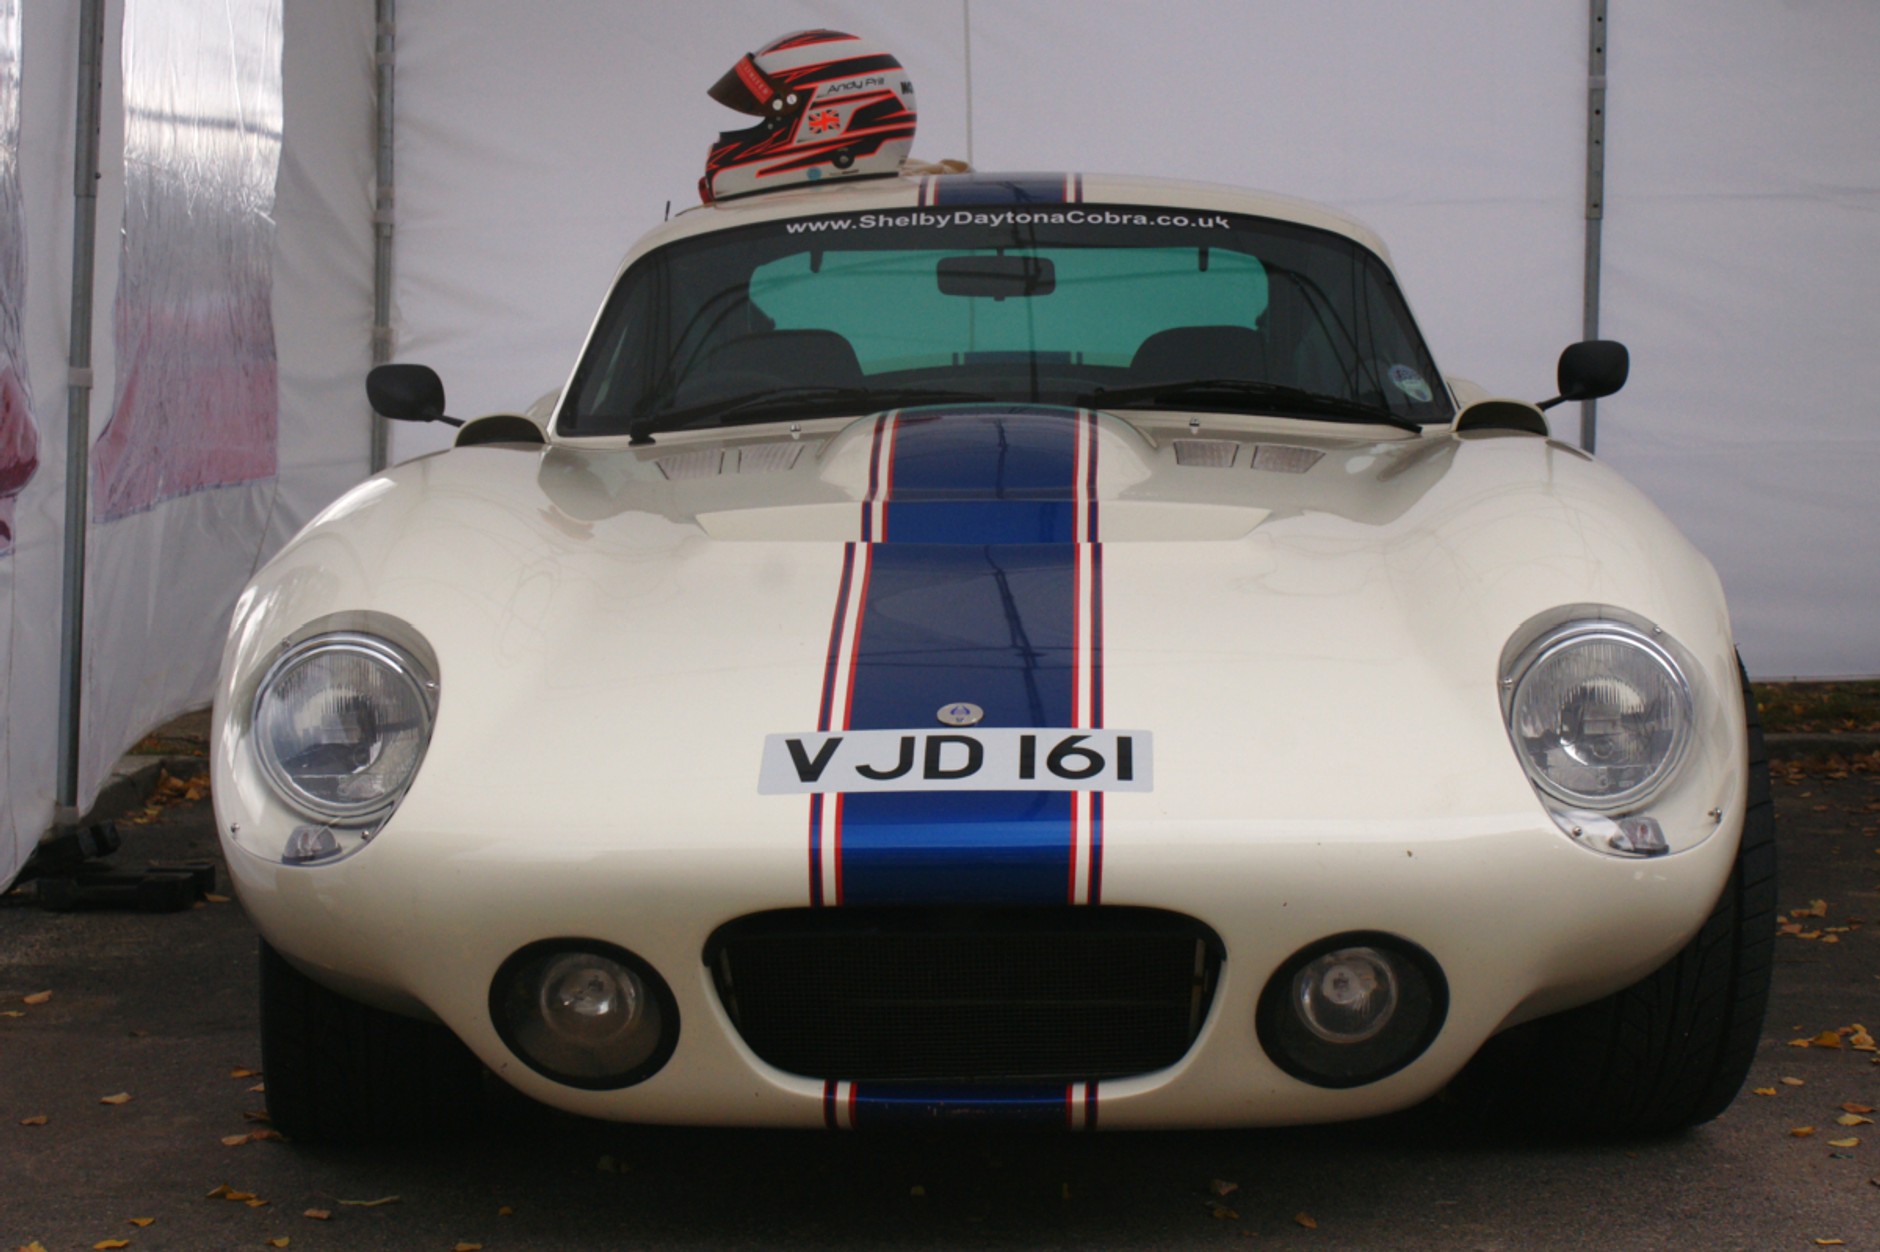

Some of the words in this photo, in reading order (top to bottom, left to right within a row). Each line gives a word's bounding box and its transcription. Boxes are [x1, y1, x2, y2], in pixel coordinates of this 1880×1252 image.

[827, 80, 863, 94] Andy
[786, 210, 1231, 234] www.ShelbyDaytonaCobra.co.uk
[1019, 734, 1133, 781] 161
